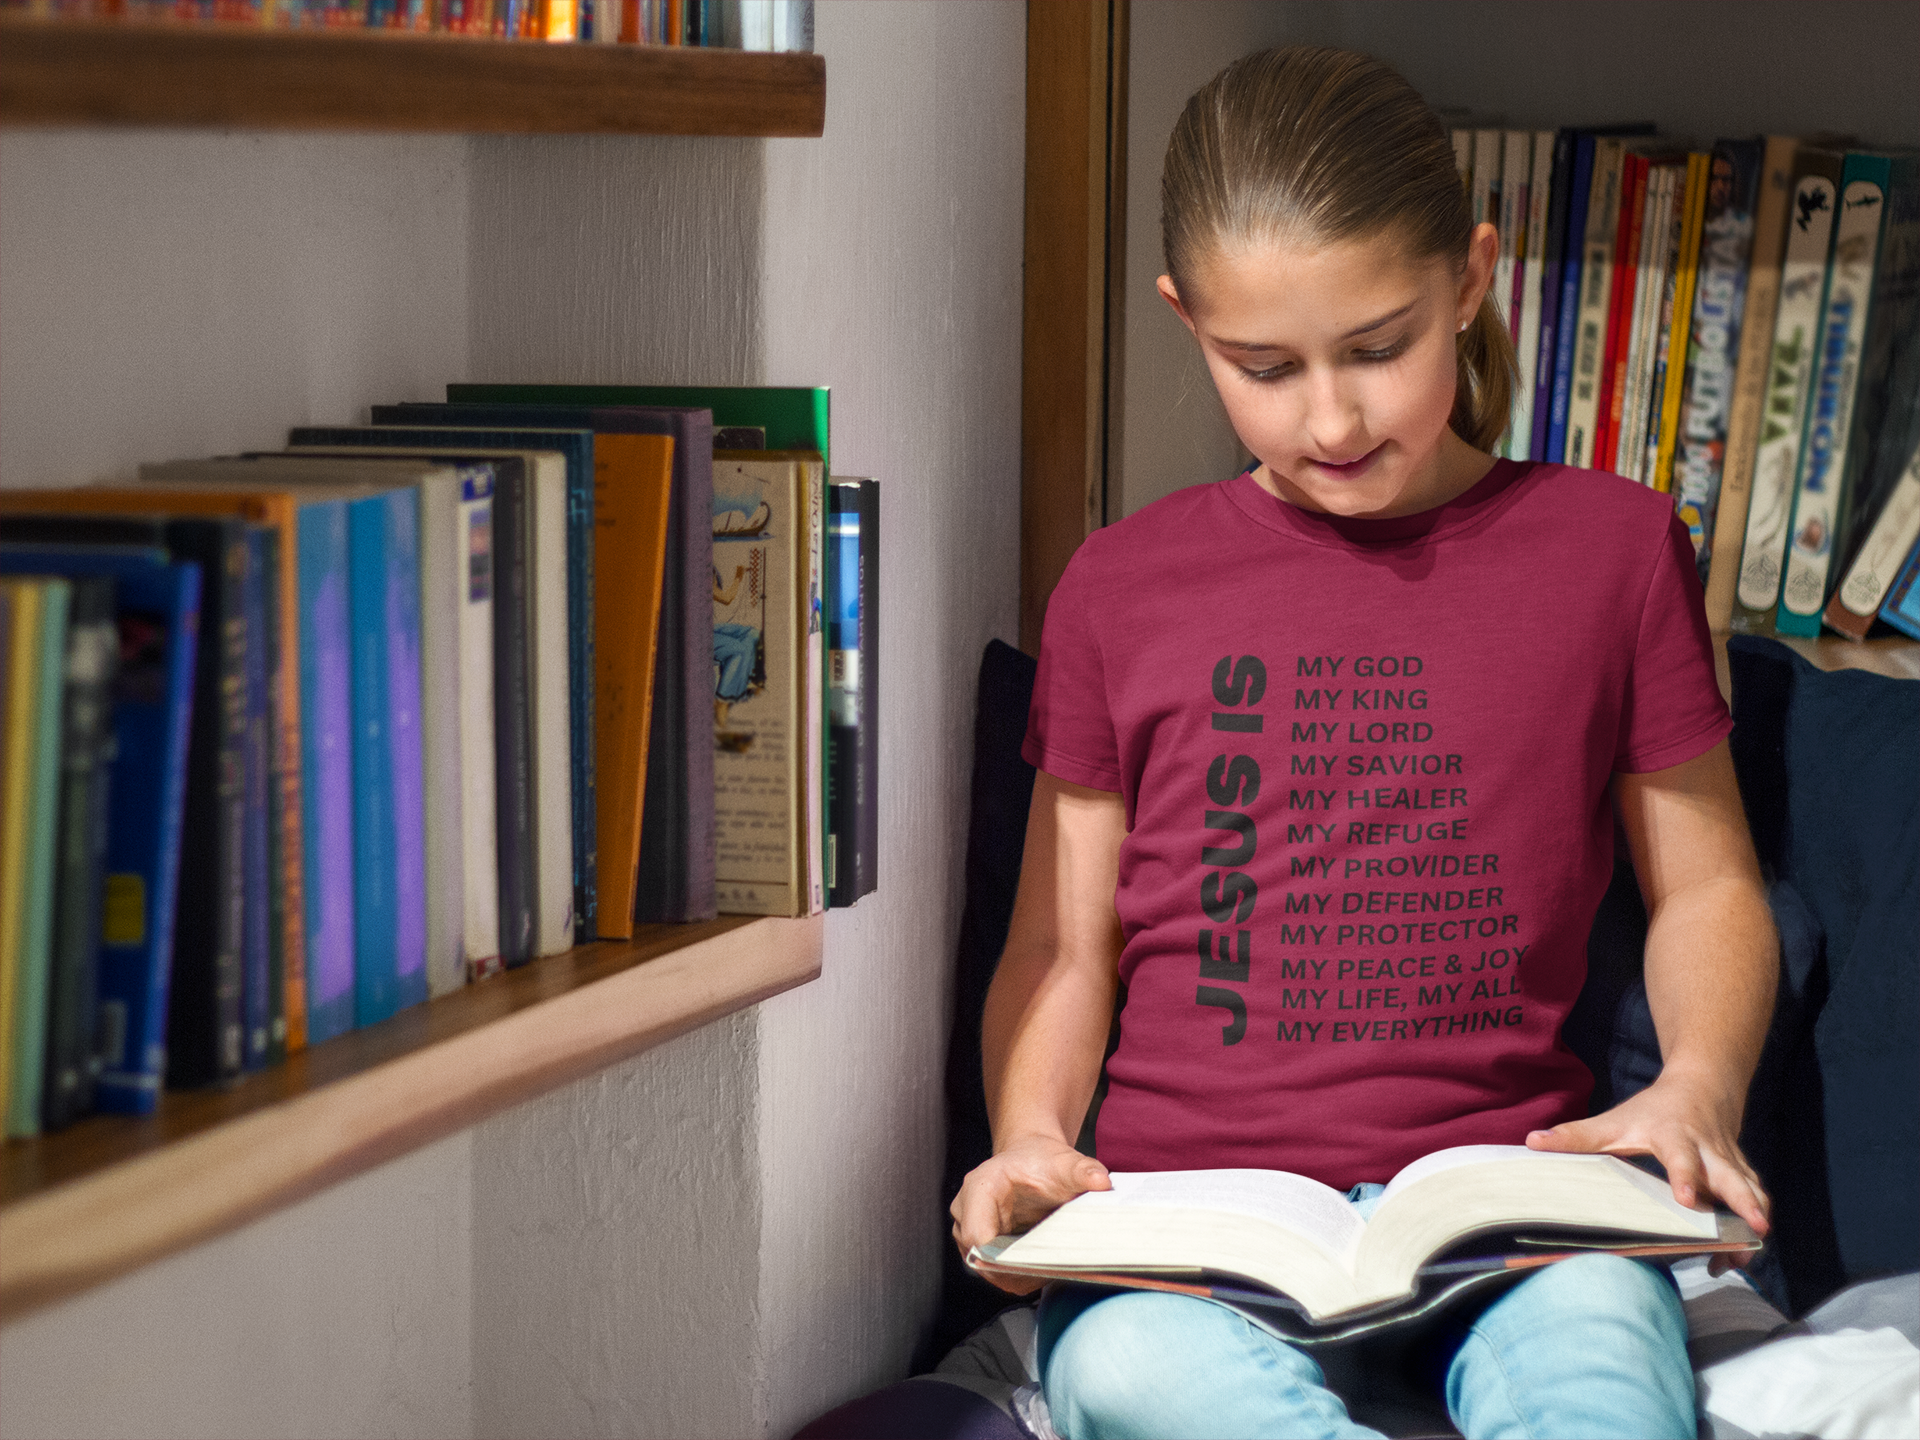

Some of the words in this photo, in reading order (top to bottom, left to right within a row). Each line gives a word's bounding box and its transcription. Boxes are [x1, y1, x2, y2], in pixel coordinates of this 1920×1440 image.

[1297, 656, 1345, 677] MY
[1354, 656, 1424, 678] GOD
[1211, 655, 1267, 733] IS
[1294, 689, 1343, 710] MY
[1352, 689, 1428, 710] KING
[1291, 722, 1339, 743] MY
[1348, 722, 1434, 743] LORD
[1290, 755, 1338, 775] MY
[1347, 754, 1463, 775] SAVIOR
[1289, 789, 1337, 810] MY
[1347, 787, 1468, 810] HEALER
[1287, 823, 1337, 844] MY
[1347, 819, 1469, 845] REFUGE
[1290, 857, 1336, 879] MY
[1344, 854, 1500, 879] PROVIDER
[1196, 754, 1262, 1046] JESUS
[1284, 892, 1332, 914] MY
[1341, 887, 1504, 915] DEFENDER
[1280, 924, 1328, 945] MY
[1336, 915, 1519, 945] PROTECTOR
[1281, 959, 1328, 980] MY
[1337, 957, 1437, 980] PEACE
[1444, 956, 1463, 974] &
[1470, 944, 1530, 972] JOY
[1281, 988, 1328, 1010] MY
[1337, 987, 1408, 1012] LIFE,
[1417, 983, 1464, 1007] MY
[1470, 975, 1522, 1001] ALL
[1276, 1021, 1324, 1042] MY
[1331, 1006, 1524, 1042] EVERYTHING
